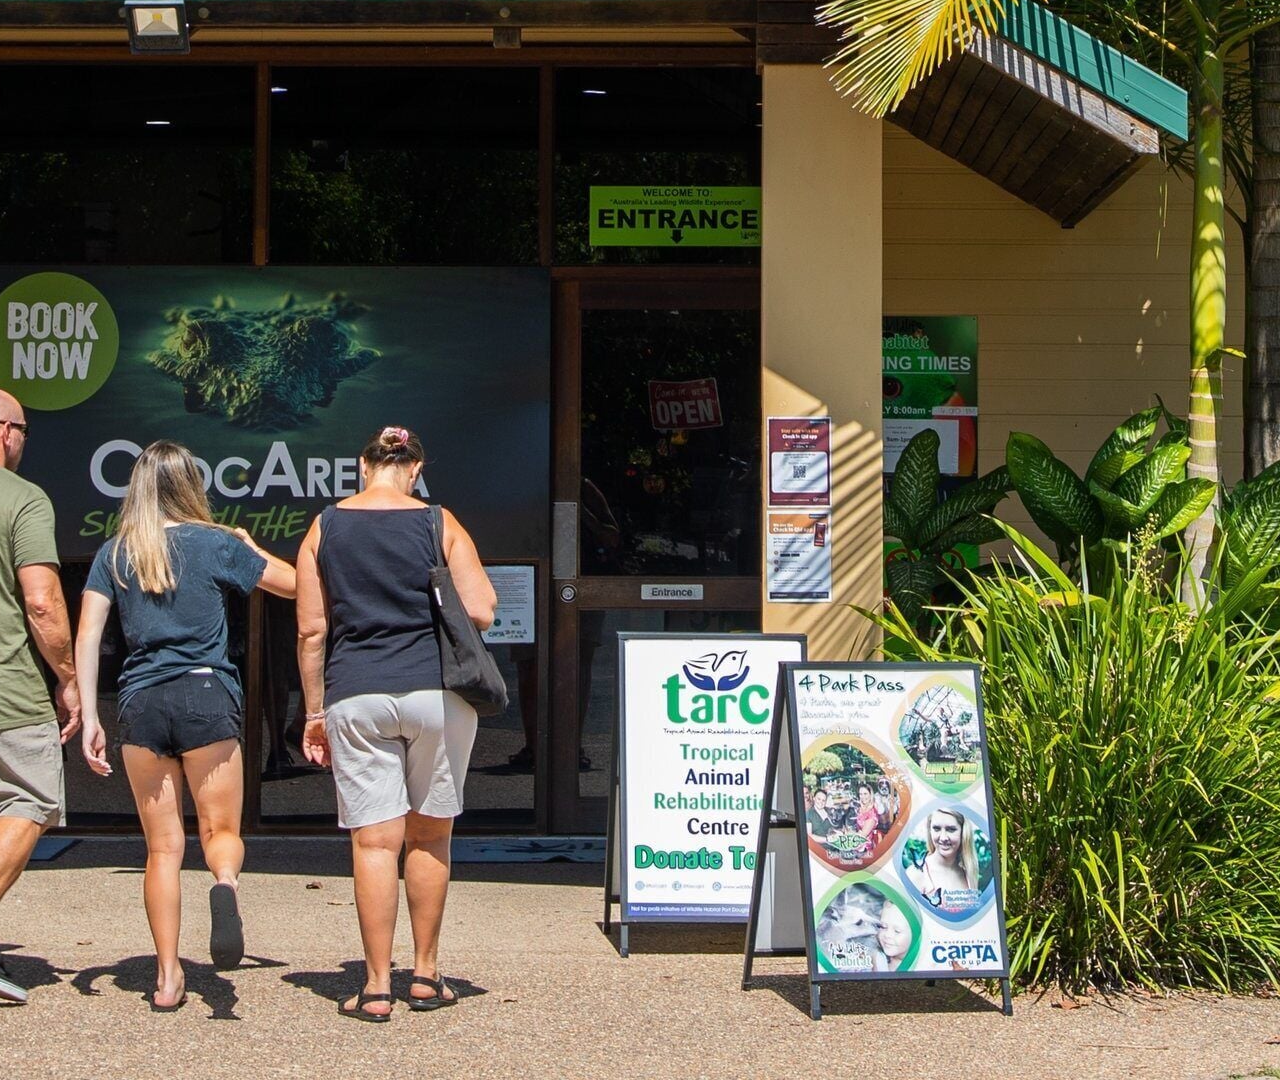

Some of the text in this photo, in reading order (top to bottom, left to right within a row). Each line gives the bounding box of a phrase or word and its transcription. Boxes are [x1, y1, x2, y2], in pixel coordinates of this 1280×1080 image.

[642, 189, 713, 197] WELCOME TO:
[650, 199, 677, 207] Leading
[598, 209, 758, 229] ENTRANCE
[7, 302, 99, 339] BOOK
[12, 342, 93, 380] NOW
[918, 356, 971, 370] TIMES
[655, 398, 715, 425] OPEN
[893, 406, 926, 414] 8:00am
[244, 505, 308, 542] THE
[651, 587, 693, 598] Entrance
[798, 674, 905, 694] 4 Park Pass
[662, 673, 770, 725] tarc
[663, 727, 685, 735] Tropical
[680, 744, 754, 765] Tropical
[685, 768, 750, 786] Animal
[654, 792, 763, 811] Rehabilitati
[687, 818, 749, 835] Centre
[634, 845, 757, 870] Donate To
